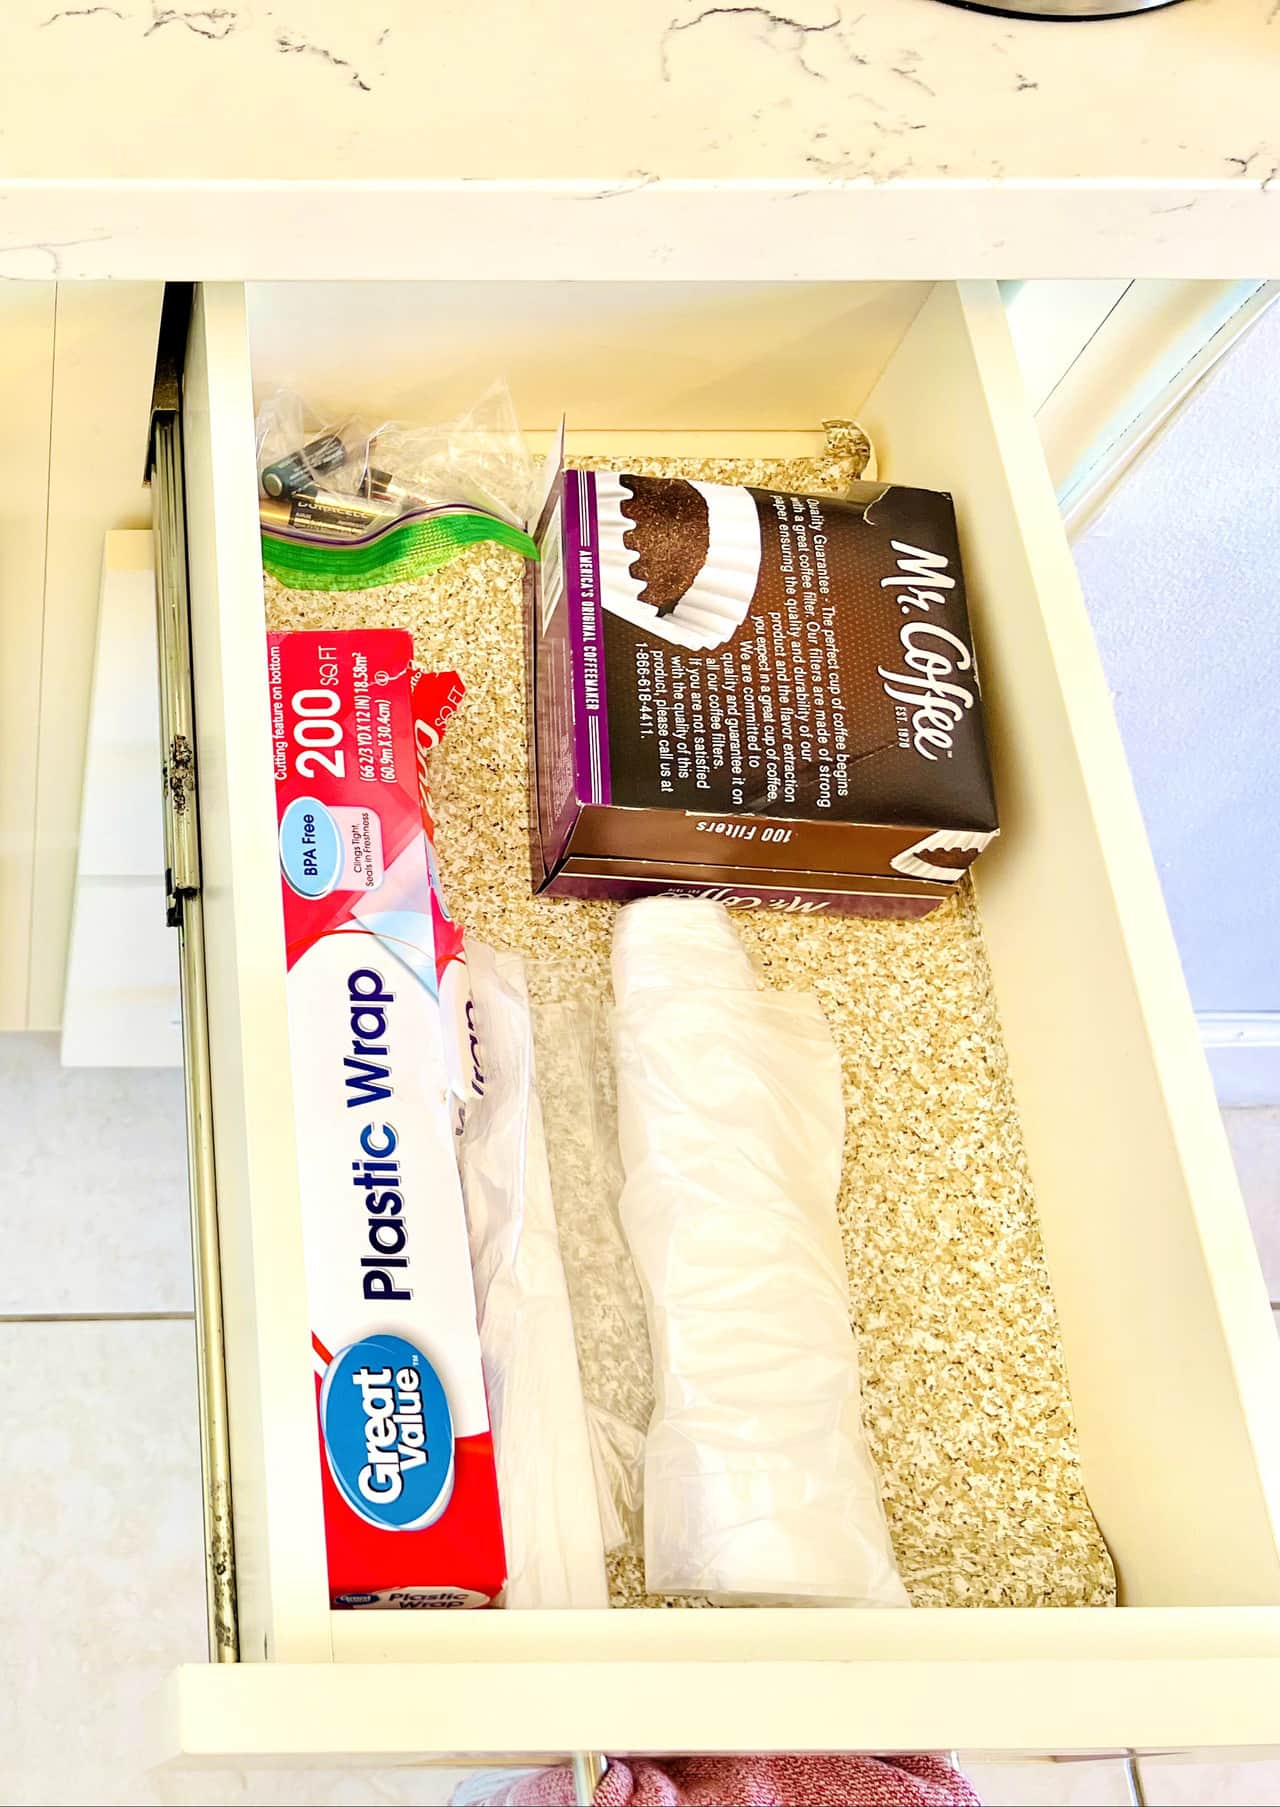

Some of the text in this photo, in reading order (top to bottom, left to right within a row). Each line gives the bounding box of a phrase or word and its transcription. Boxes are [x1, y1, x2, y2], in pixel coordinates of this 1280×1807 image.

[806, 498, 824, 531] Quality
[792, 524, 810, 552] great
[799, 555, 813, 588] coffee
[811, 534, 830, 594] Guarantee
[803, 592, 816, 618] filter.
[822, 606, 835, 626] The
[578, 551, 599, 710] AMERICA'S ORIGINAL COFFEEMAKER
[751, 615, 767, 635] you
[770, 494, 812, 762] paper ensuring the quality and durability of our
[807, 621, 820, 644] Our
[754, 637, 771, 672] expect
[809, 648, 822, 681] filters
[821, 629, 839, 669] perfect
[877, 540, 974, 760] Mr. Coffee
[635, 642, 654, 739] 1-866-618-4411.
[760, 674, 773, 683] in
[813, 686, 826, 705] are
[826, 672, 840, 694] cup
[269, 646, 288, 780] Cutting feature on bottom
[291, 645, 345, 778] 200 SQ FT
[354, 695, 372, 709] IN)
[356, 712, 371, 723] 12
[671, 656, 693, 779] with the quality of this
[705, 658, 726, 769] all our coffee filters.
[739, 640, 762, 768] We are committed to
[758, 695, 774, 723] great
[769, 612, 798, 803] product and the flavor extraction
[831, 698, 845, 711] of
[375, 700, 391, 739] 30.4cm)
[651, 650, 674, 793] product, please call us at
[685, 658, 711, 789] If you are not satisfied
[721, 652, 746, 805] quality and guarantee it on
[761, 726, 776, 746] cup
[815, 710, 830, 744] made
[833, 713, 848, 750] coffee
[895, 706, 911, 748] EST. 1970
[358, 733, 373, 745] YD
[359, 748, 374, 764] 2/3
[766, 749, 779, 760] of
[819, 748, 833, 762] of
[360, 762, 377, 782] (66
[380, 749, 398, 783] (60.9m
[767, 763, 781, 802] coffee.
[834, 754, 850, 796] begins
[817, 765, 832, 808] strong
[301, 814, 318, 876] BPA Free
[695, 821, 793, 843] 100 Filters
[352, 843, 363, 873] Clings
[362, 812, 374, 888] Seals in Freshness
[342, 966, 414, 1302] Plastic Wrap
[352, 1366, 404, 1504] Great
[392, 1366, 429, 1472] Value
[388, 1593, 469, 1601] Plastic
[399, 1601, 464, 1609] Wrap
